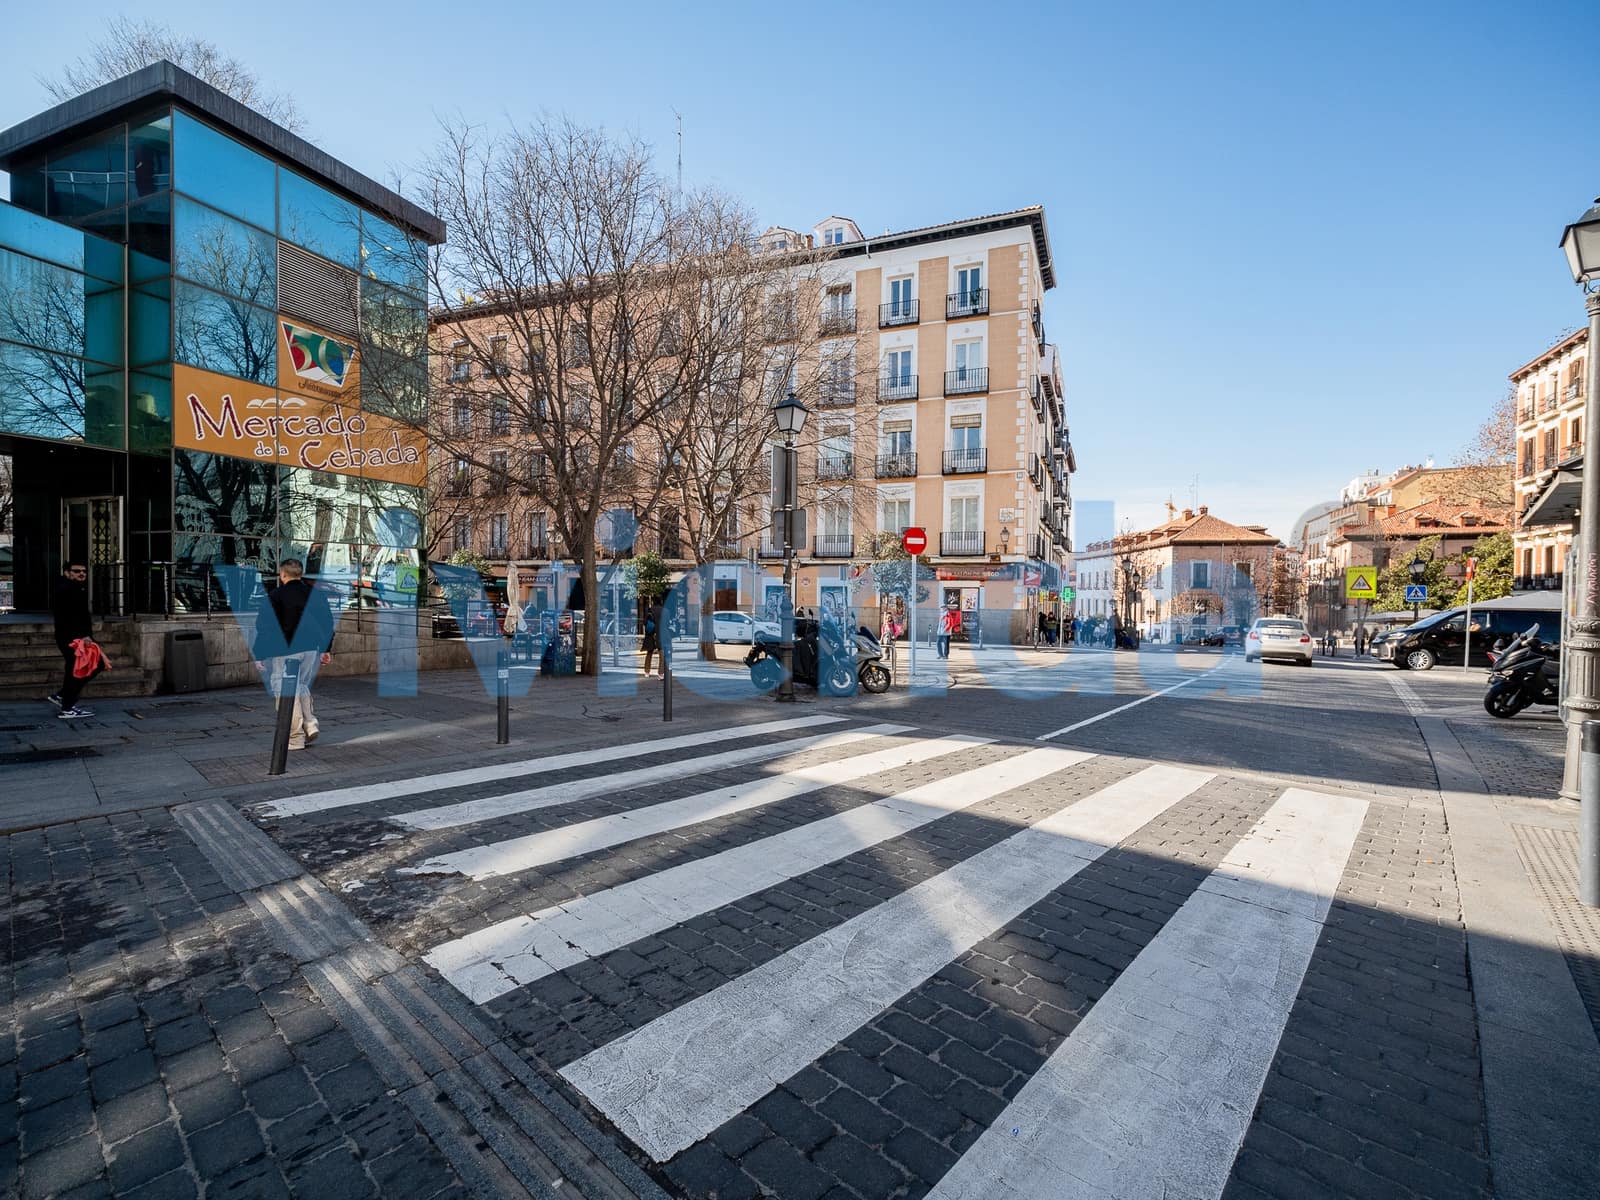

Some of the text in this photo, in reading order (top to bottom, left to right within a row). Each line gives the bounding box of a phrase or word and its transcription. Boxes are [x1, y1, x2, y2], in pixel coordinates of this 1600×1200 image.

[187, 393, 366, 440] Mercado
[255, 432, 420, 471] de la Cebada
